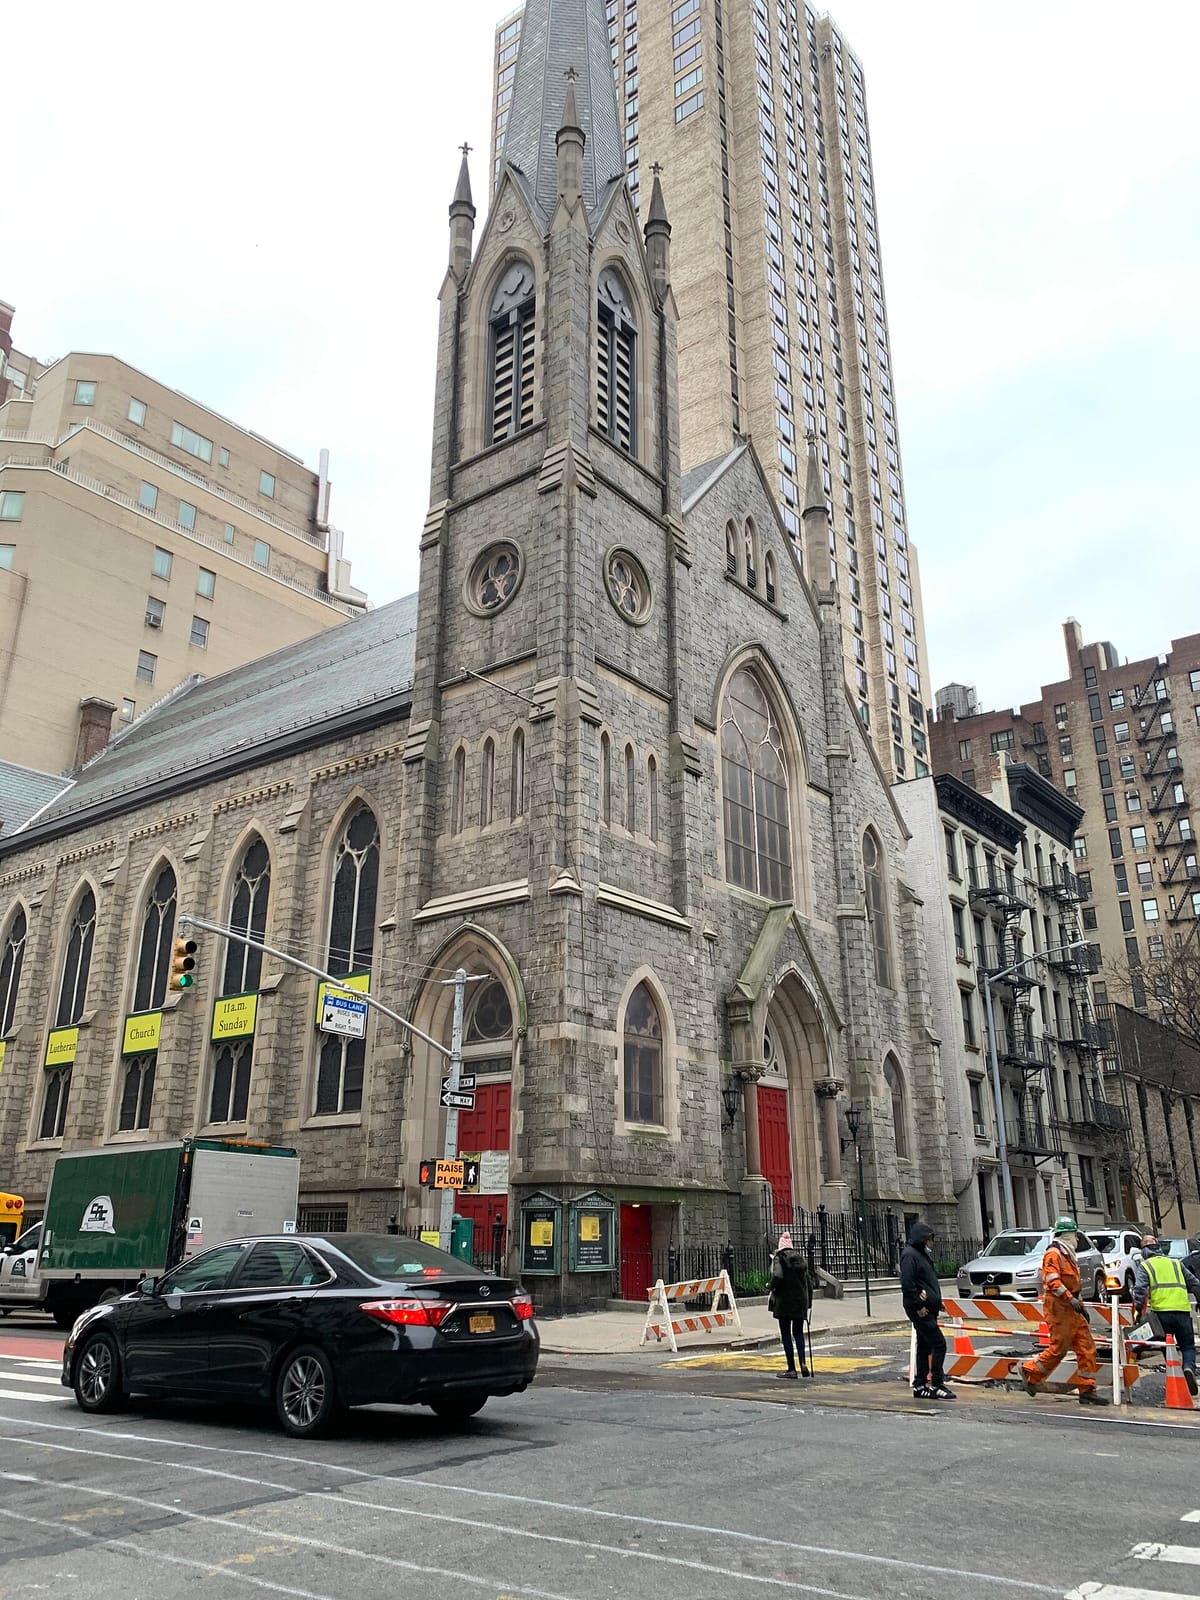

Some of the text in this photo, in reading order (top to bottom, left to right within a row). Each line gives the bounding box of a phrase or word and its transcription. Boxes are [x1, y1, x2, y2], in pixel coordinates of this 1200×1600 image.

[336, 1000, 364, 1012] BUS LANE
[218, 1016, 248, 1032] Sunday
[129, 1024, 155, 1040] Church
[49, 1041, 77, 1054] Lutheran
[437, 1163, 463, 1173] RAISE
[437, 1176, 463, 1185] PLOW
